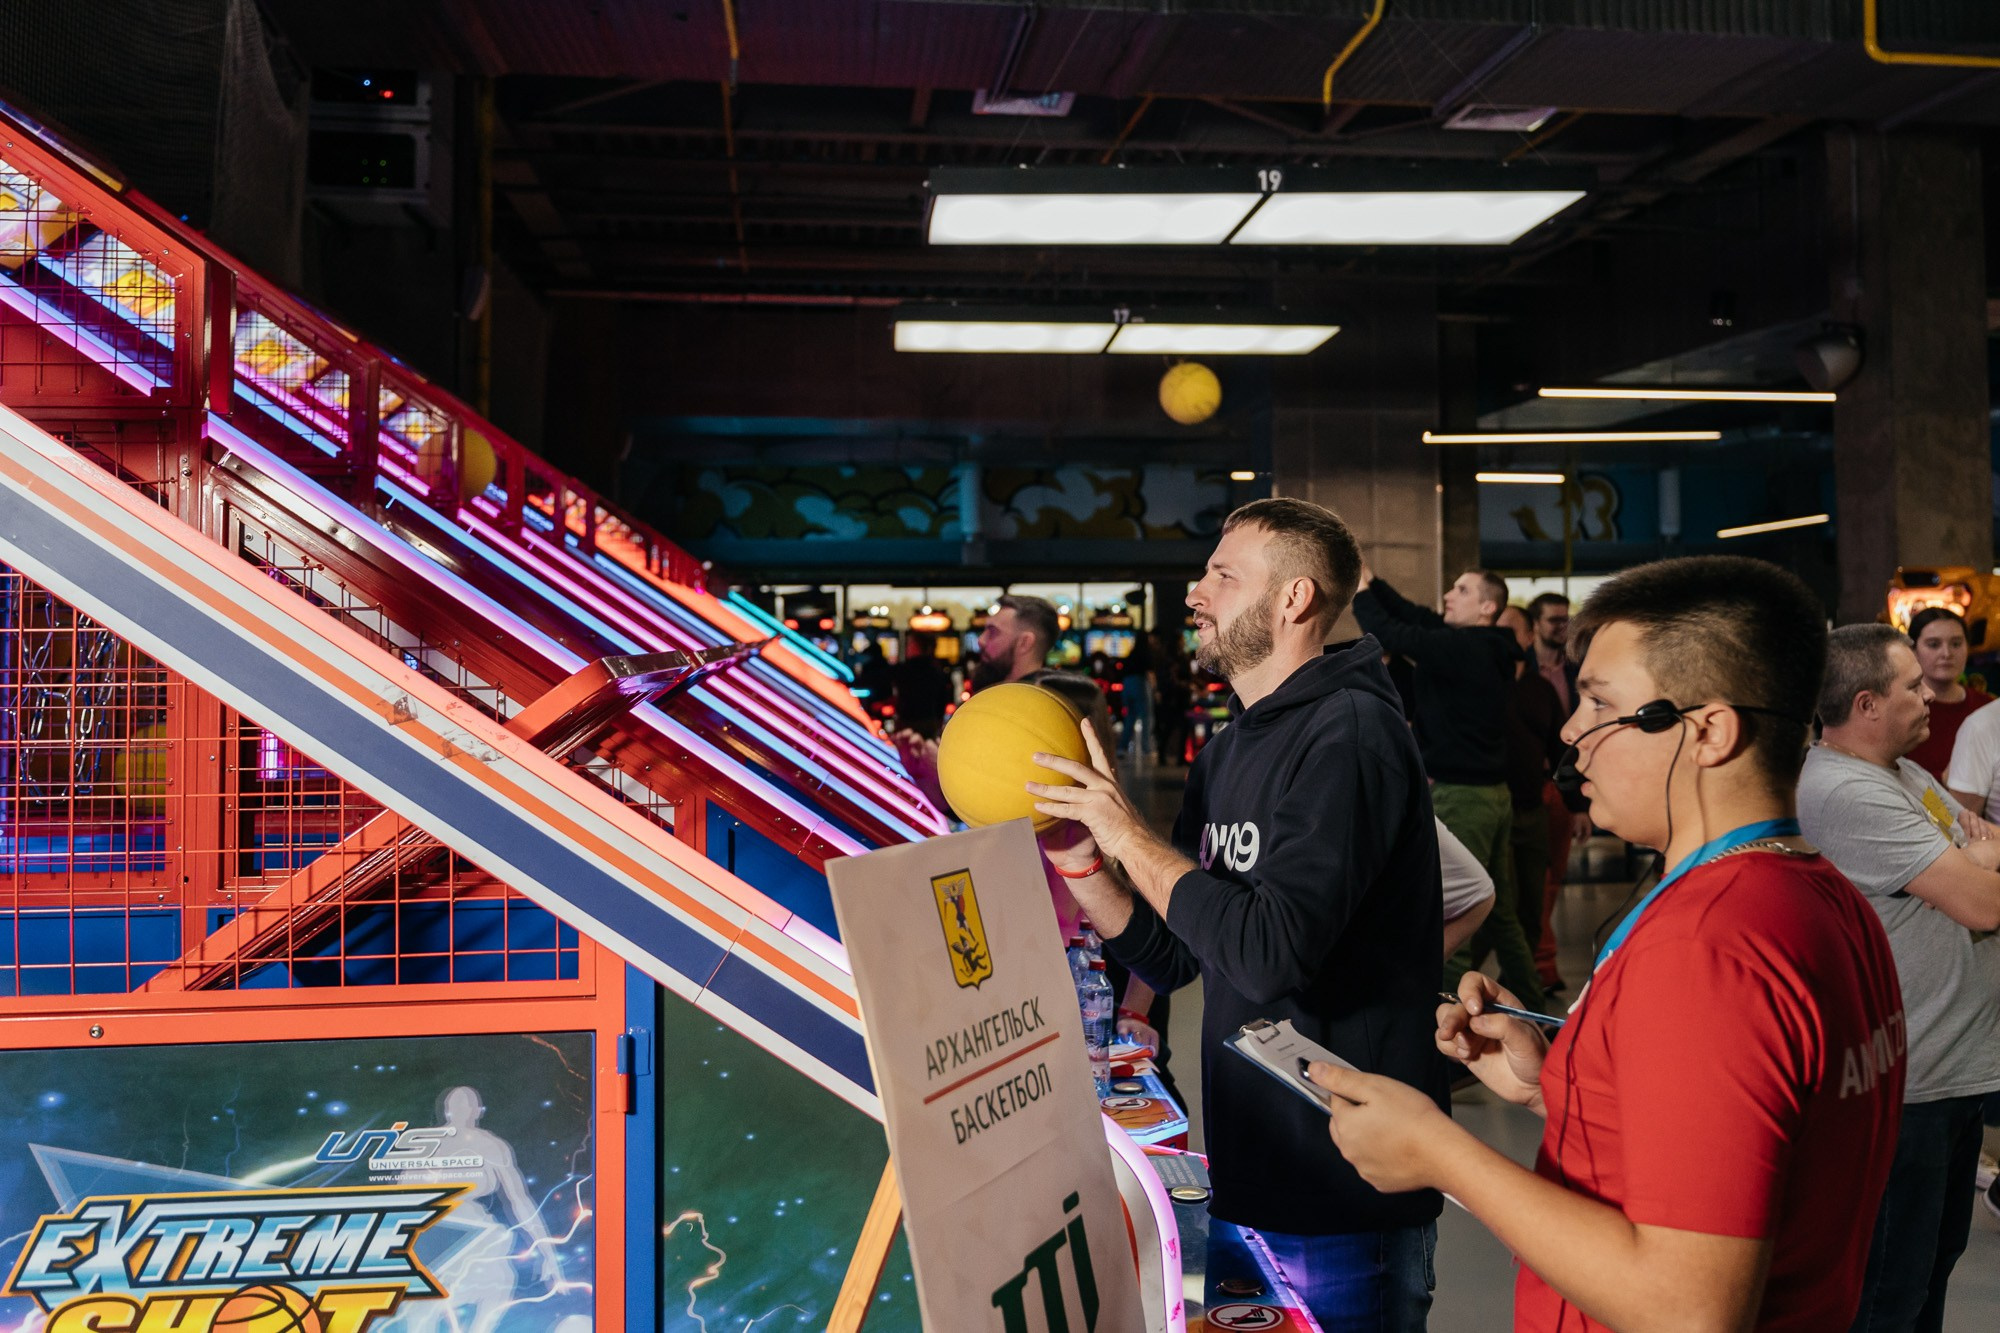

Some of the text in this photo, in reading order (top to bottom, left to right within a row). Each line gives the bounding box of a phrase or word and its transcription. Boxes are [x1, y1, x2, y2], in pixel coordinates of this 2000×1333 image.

[1258, 169, 1282, 192] 19
[1113, 308, 1130, 323] 17
[926, 996, 1045, 1080] АРХАНГЕЛЬСК
[950, 1062, 1052, 1144] БАСКЕТБОЛ
[371, 1158, 480, 1169] UNIVERSAL SPACE
[10, 1188, 455, 1303] EXTREME
